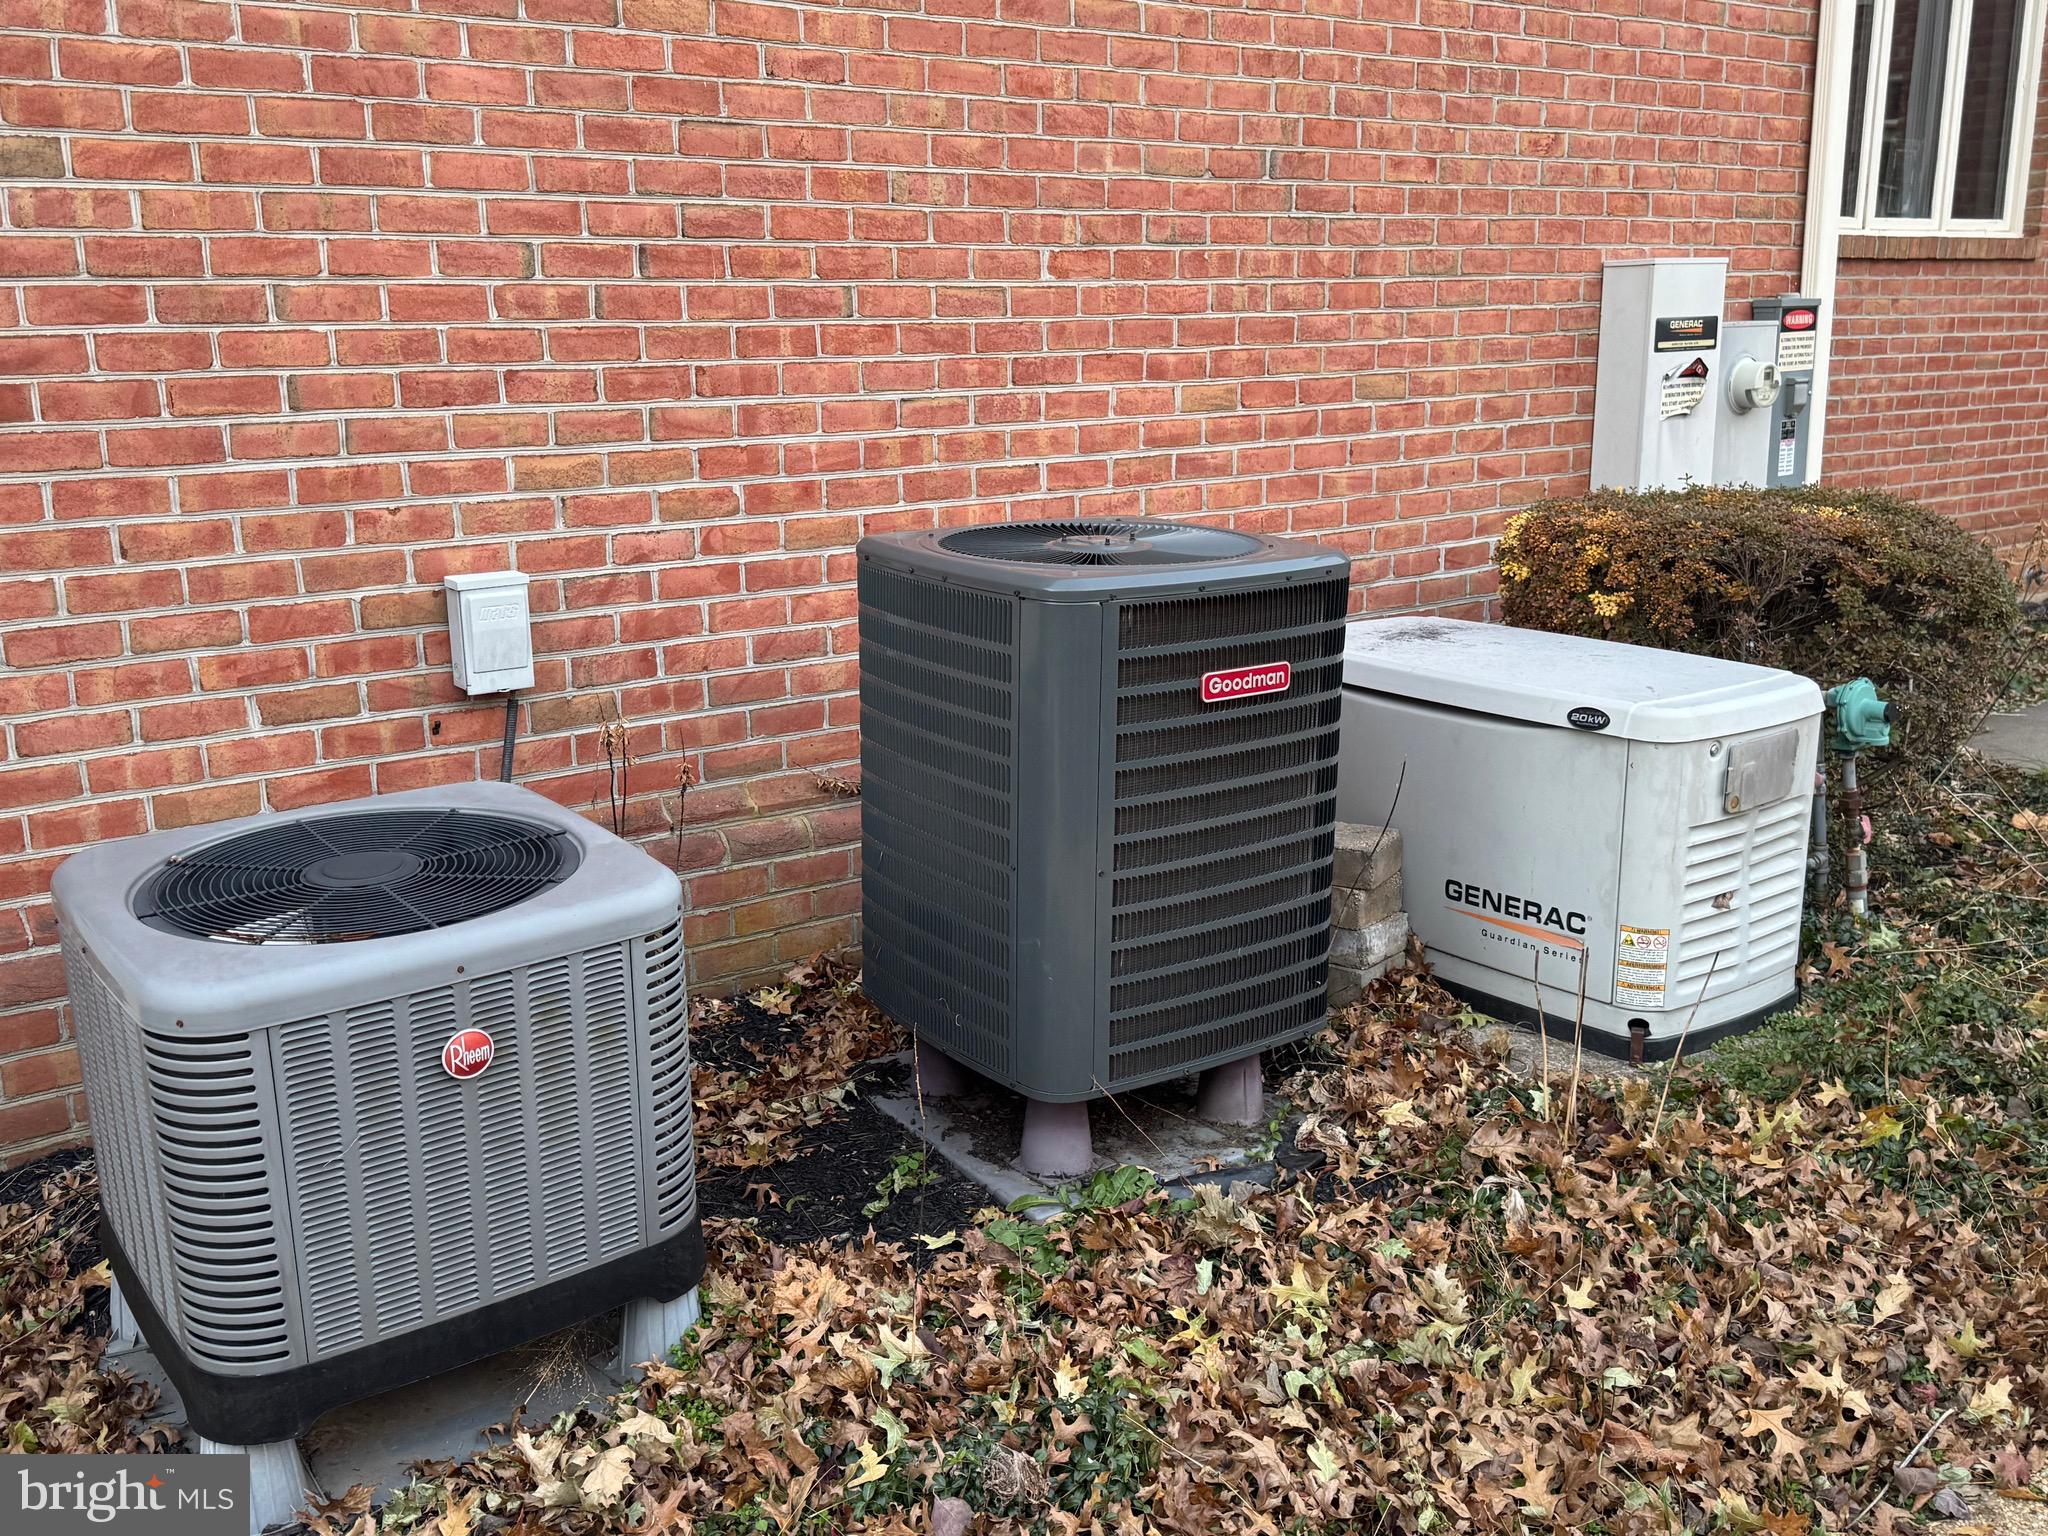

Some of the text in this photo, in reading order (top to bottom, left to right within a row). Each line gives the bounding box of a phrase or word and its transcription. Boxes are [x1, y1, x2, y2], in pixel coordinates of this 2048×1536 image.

[1669, 319, 1704, 329] GENERAC
[1784, 313, 1814, 325] WARNING
[1209, 671, 1285, 694] Goodman
[1571, 713, 1605, 724] 20kW
[1445, 879, 1586, 935] GENERAC
[1481, 929, 1536, 951] Guardian
[450, 1035, 490, 1073] Rheem
